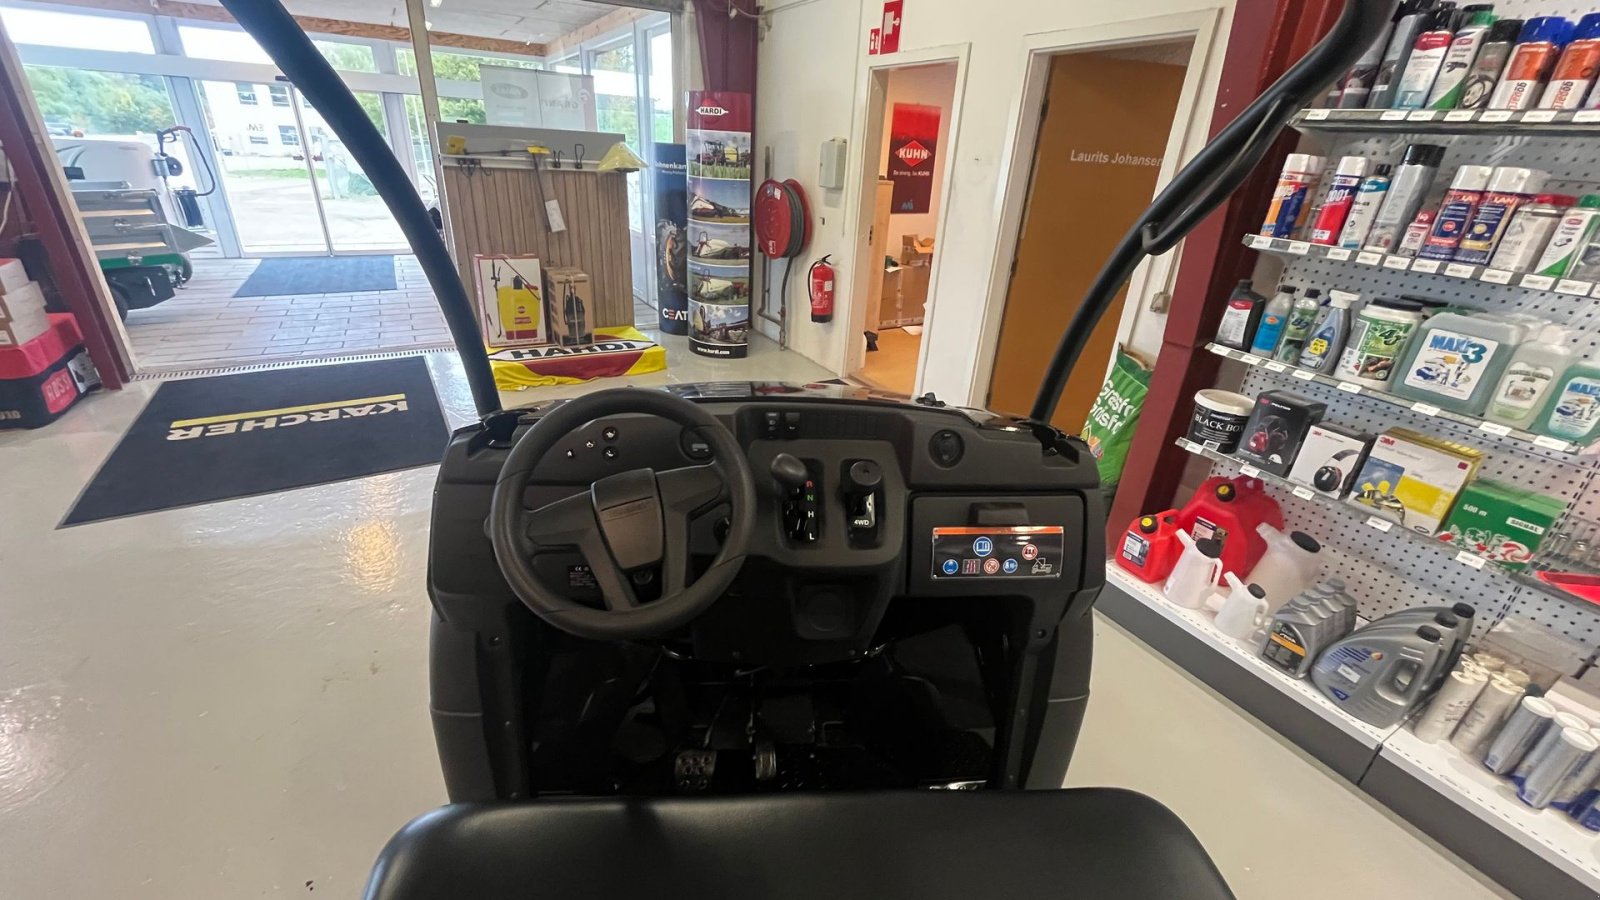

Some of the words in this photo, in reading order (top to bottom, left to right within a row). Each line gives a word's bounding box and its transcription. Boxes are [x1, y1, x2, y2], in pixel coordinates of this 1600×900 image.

[899, 148, 928, 160] KUHN
[1070, 149, 1110, 163] Laurits
[662, 308, 688, 321] CEAT
[1461, 343, 1487, 363] 3
[1194, 413, 1225, 431] BLACK
[1380, 436, 1395, 446] 3M
[808, 510, 815, 518] H
[1463, 503, 1479, 513] 500
[1478, 509, 1488, 517] m
[809, 532, 815, 540] L
